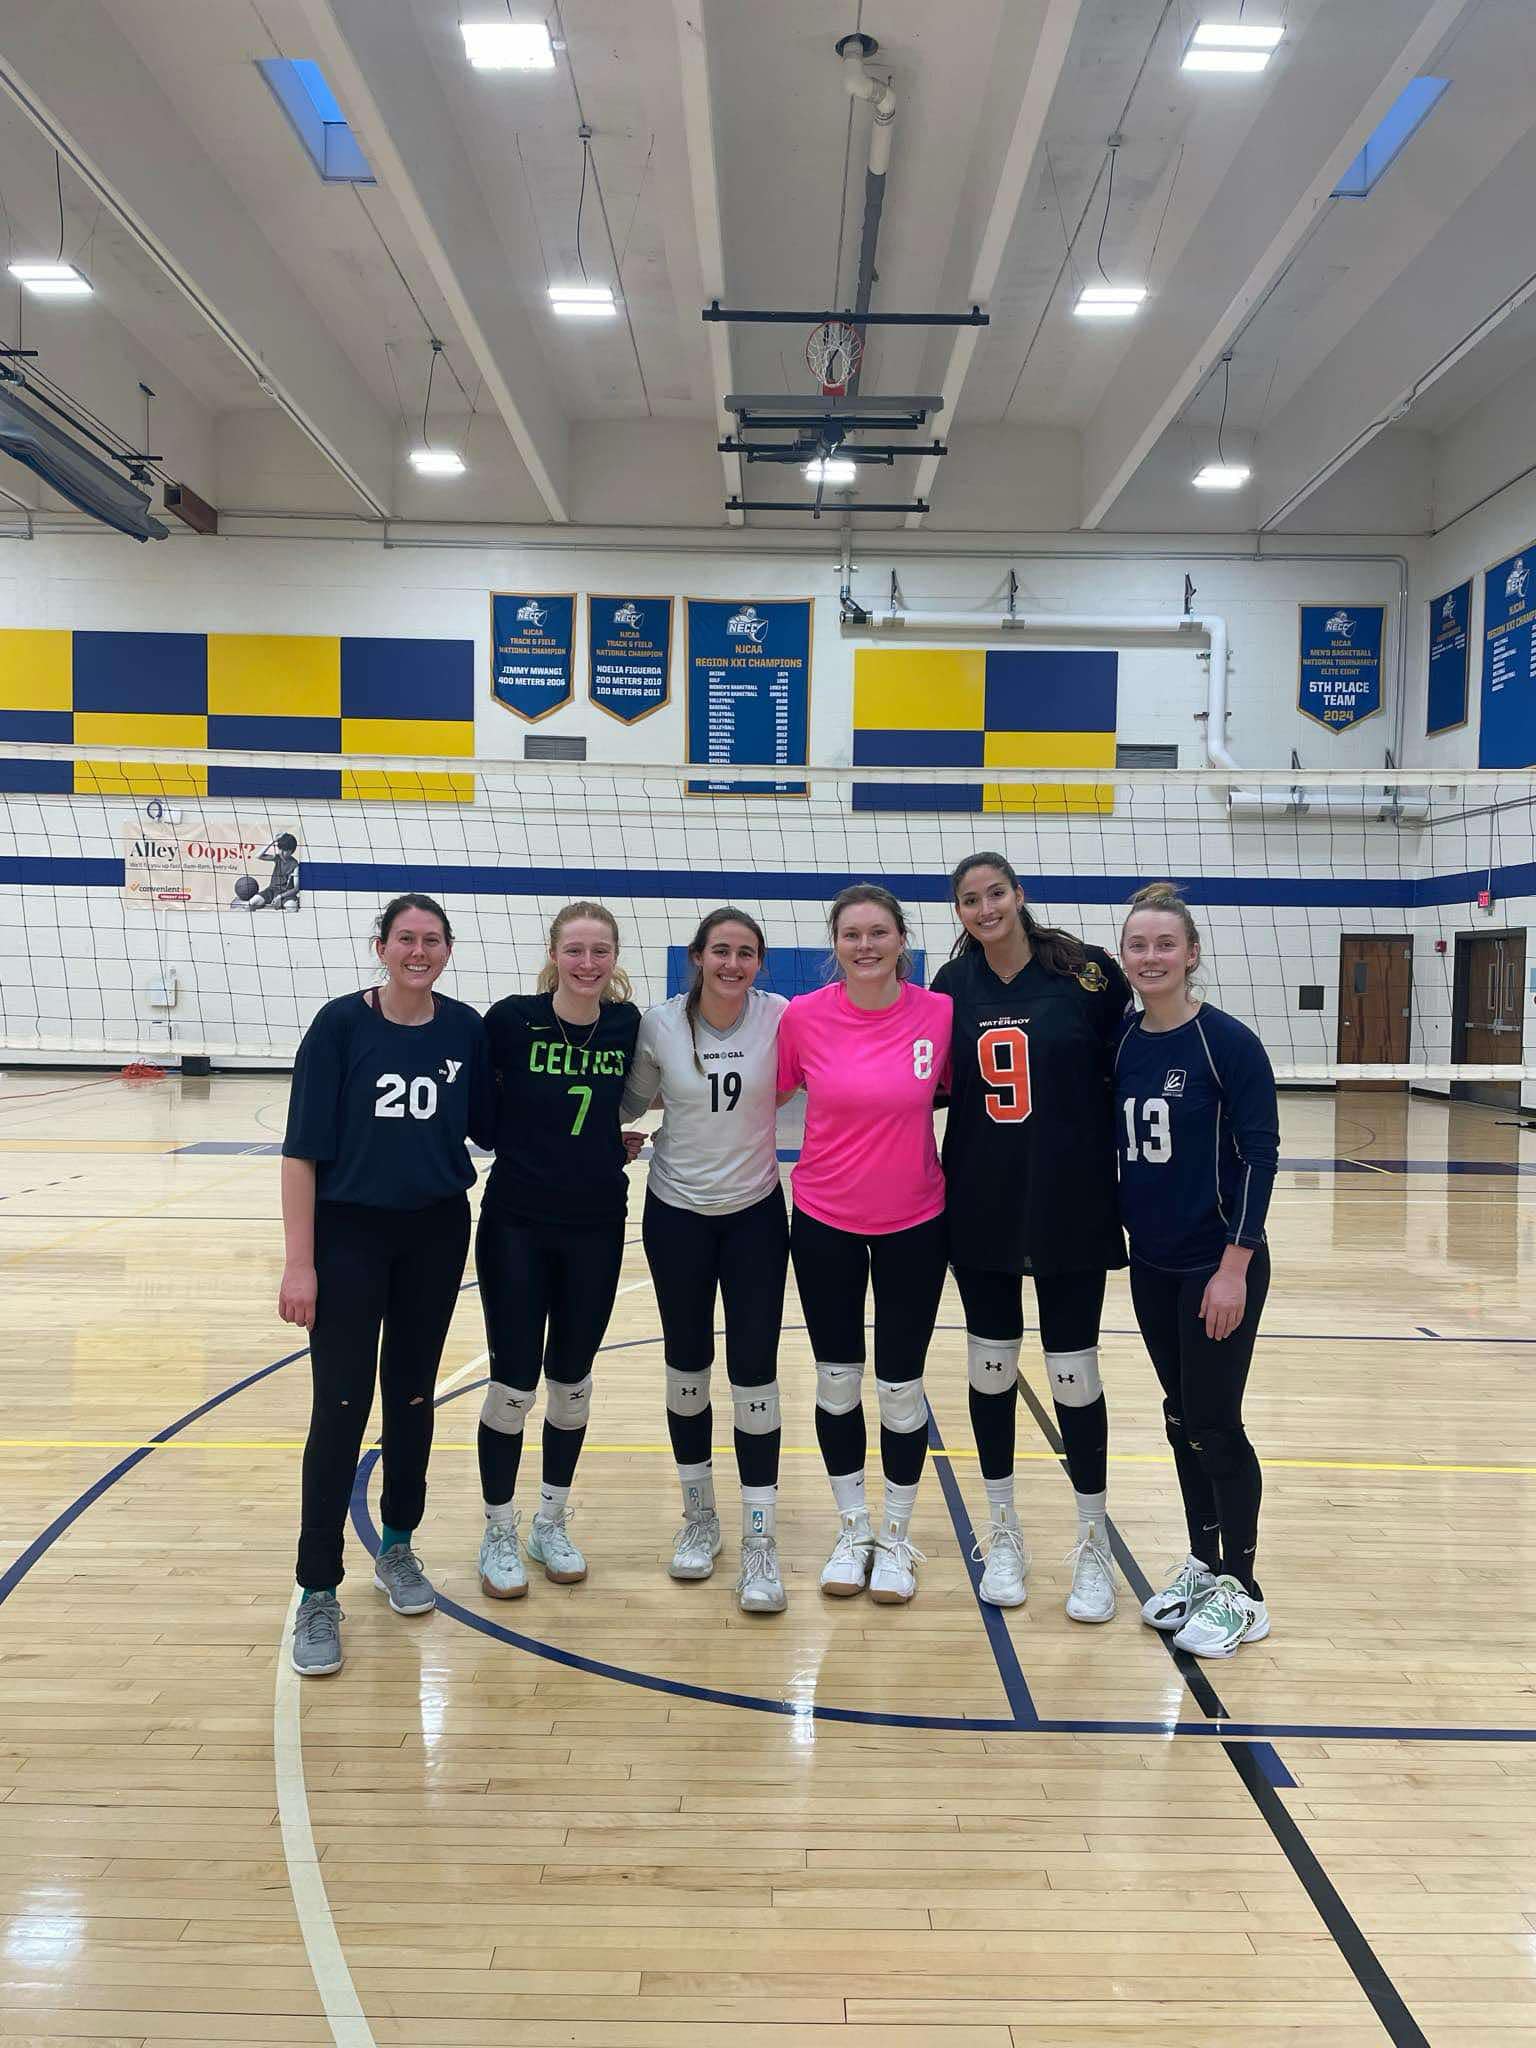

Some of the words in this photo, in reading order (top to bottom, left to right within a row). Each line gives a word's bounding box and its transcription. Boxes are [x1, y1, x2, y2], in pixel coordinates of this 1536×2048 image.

[518, 612, 541, 620] NECC
[614, 615, 637, 623] NECC
[728, 624, 758, 633] NECC
[1325, 623, 1349, 631] NECC
[735, 645, 763, 654] NJCAA
[1332, 649, 1371, 657] BASKETBALL
[696, 658, 729, 667] REGION
[730, 659, 747, 667] XXI
[748, 660, 802, 668] CHAMPIONS
[530, 667, 562, 675] MWANGI
[597, 665, 624, 674] NOELIA
[1321, 668, 1339, 676] ELITE
[1340, 668, 1360, 676] EIGHT
[499, 677, 514, 685] 400
[515, 678, 545, 686] METERS
[596, 676, 611, 684] 200
[612, 677, 642, 685] METERS
[597, 687, 611, 695] 100
[612, 688, 642, 696] METERS
[1310, 681, 1332, 693] 5TH
[1335, 681, 1370, 693] PLACE
[1323, 694, 1355, 706] TEAM
[1323, 710, 1354, 721] 2024
[130, 841, 178, 862] Alley
[187, 842, 256, 863] Oops!?
[980, 1018, 1031, 1027] WATERBOY
[529, 1041, 626, 1076] CELTICS
[703, 1052, 720, 1060] NOR
[913, 1039, 933, 1080] 8
[445, 1058, 463, 1083] Y
[977, 1026, 1032, 1123] 9
[374, 1073, 438, 1120] 20
[707, 1071, 742, 1113] 19
[567, 1085, 593, 1136] 7
[1123, 1097, 1172, 1163] 13
